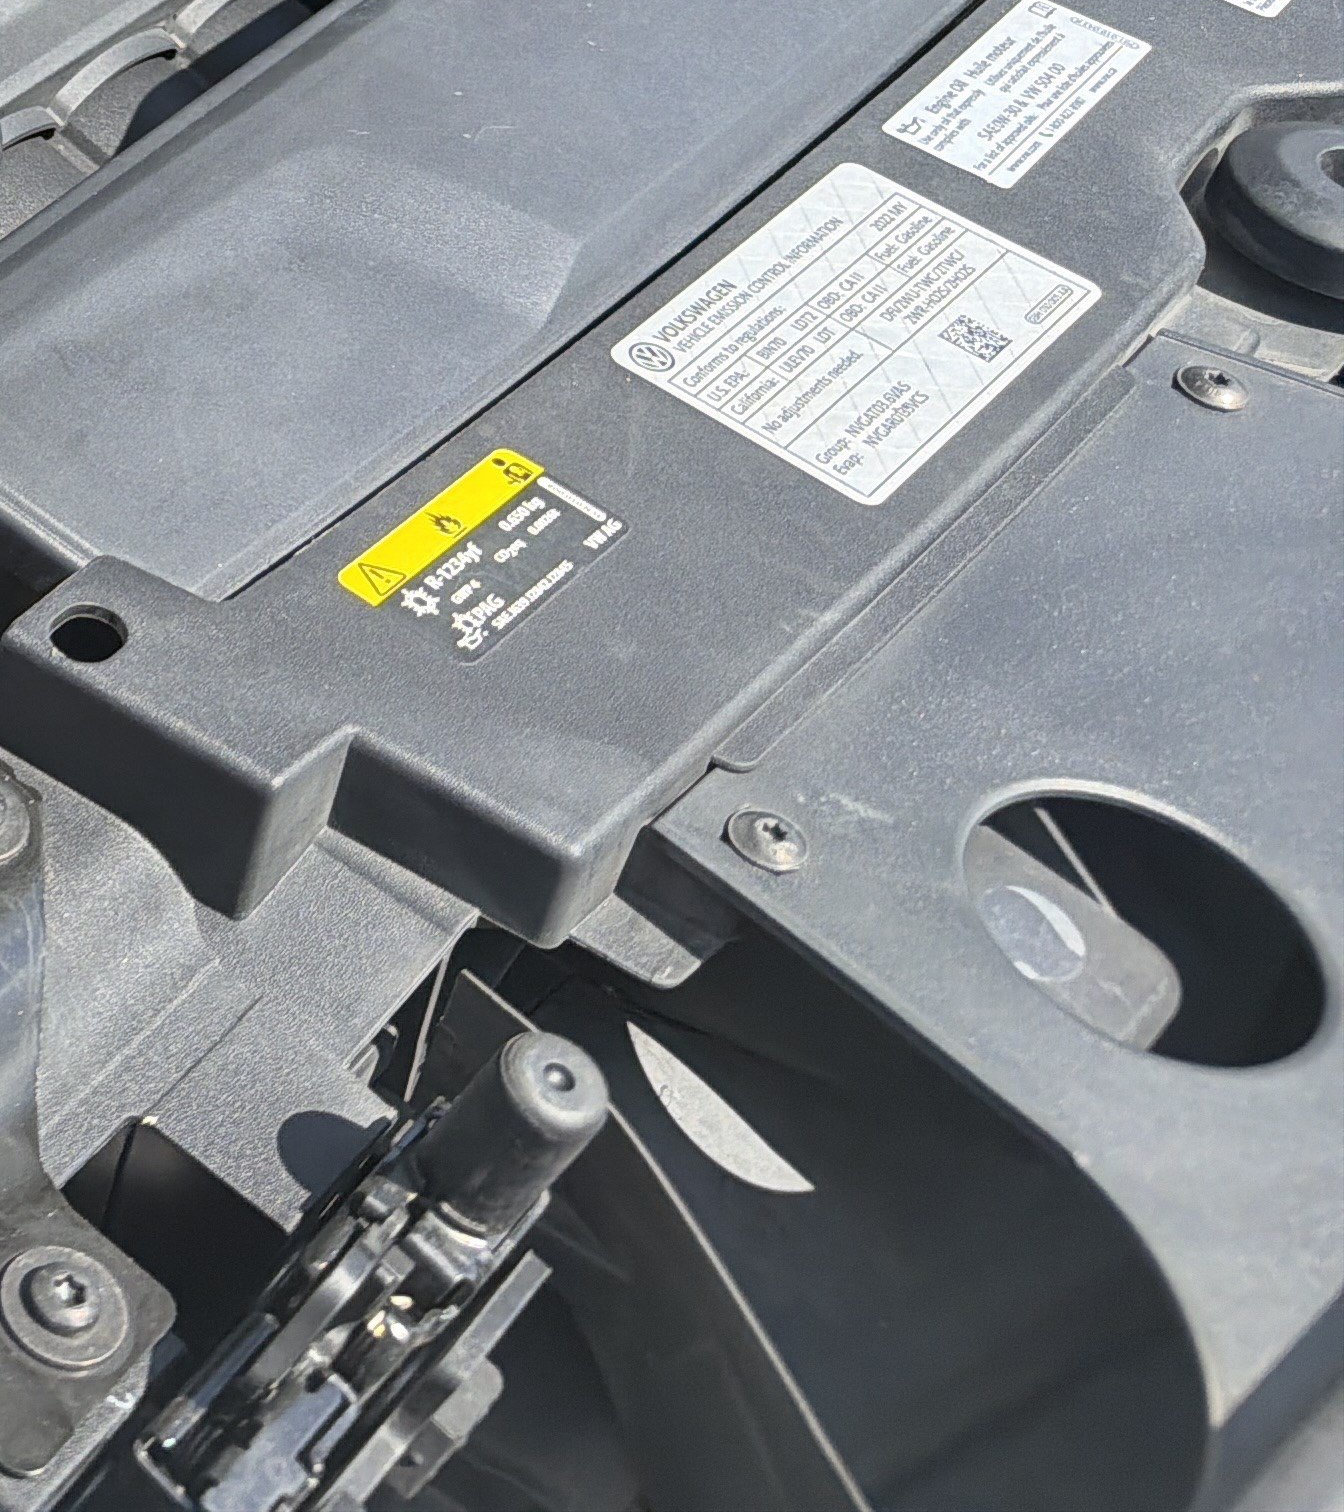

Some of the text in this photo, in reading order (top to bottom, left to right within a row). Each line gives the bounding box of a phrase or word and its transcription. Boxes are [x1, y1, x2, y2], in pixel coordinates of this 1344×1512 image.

[868, 213, 896, 231] 2022
[892, 214, 934, 244] Gasoline
[914, 224, 956, 256] Gasoline
[672, 216, 844, 353] VEHICLE EMISSION CONTROL INFORMATION
[651, 279, 737, 344] VOLKSWAGEN
[680, 303, 790, 387] Conforms to regulations:
[706, 367, 751, 402] U.S. EPA:
[727, 374, 780, 416] California:
[760, 347, 864, 434] No adjustments needed.
[813, 434, 856, 467] Group:
[831, 449, 869, 478] Evap:
[583, 518, 623, 549] VW AG
[423, 542, 487, 591] R-1234yf
[471, 593, 506, 620] PAG
[491, 612, 513, 628] SAE
